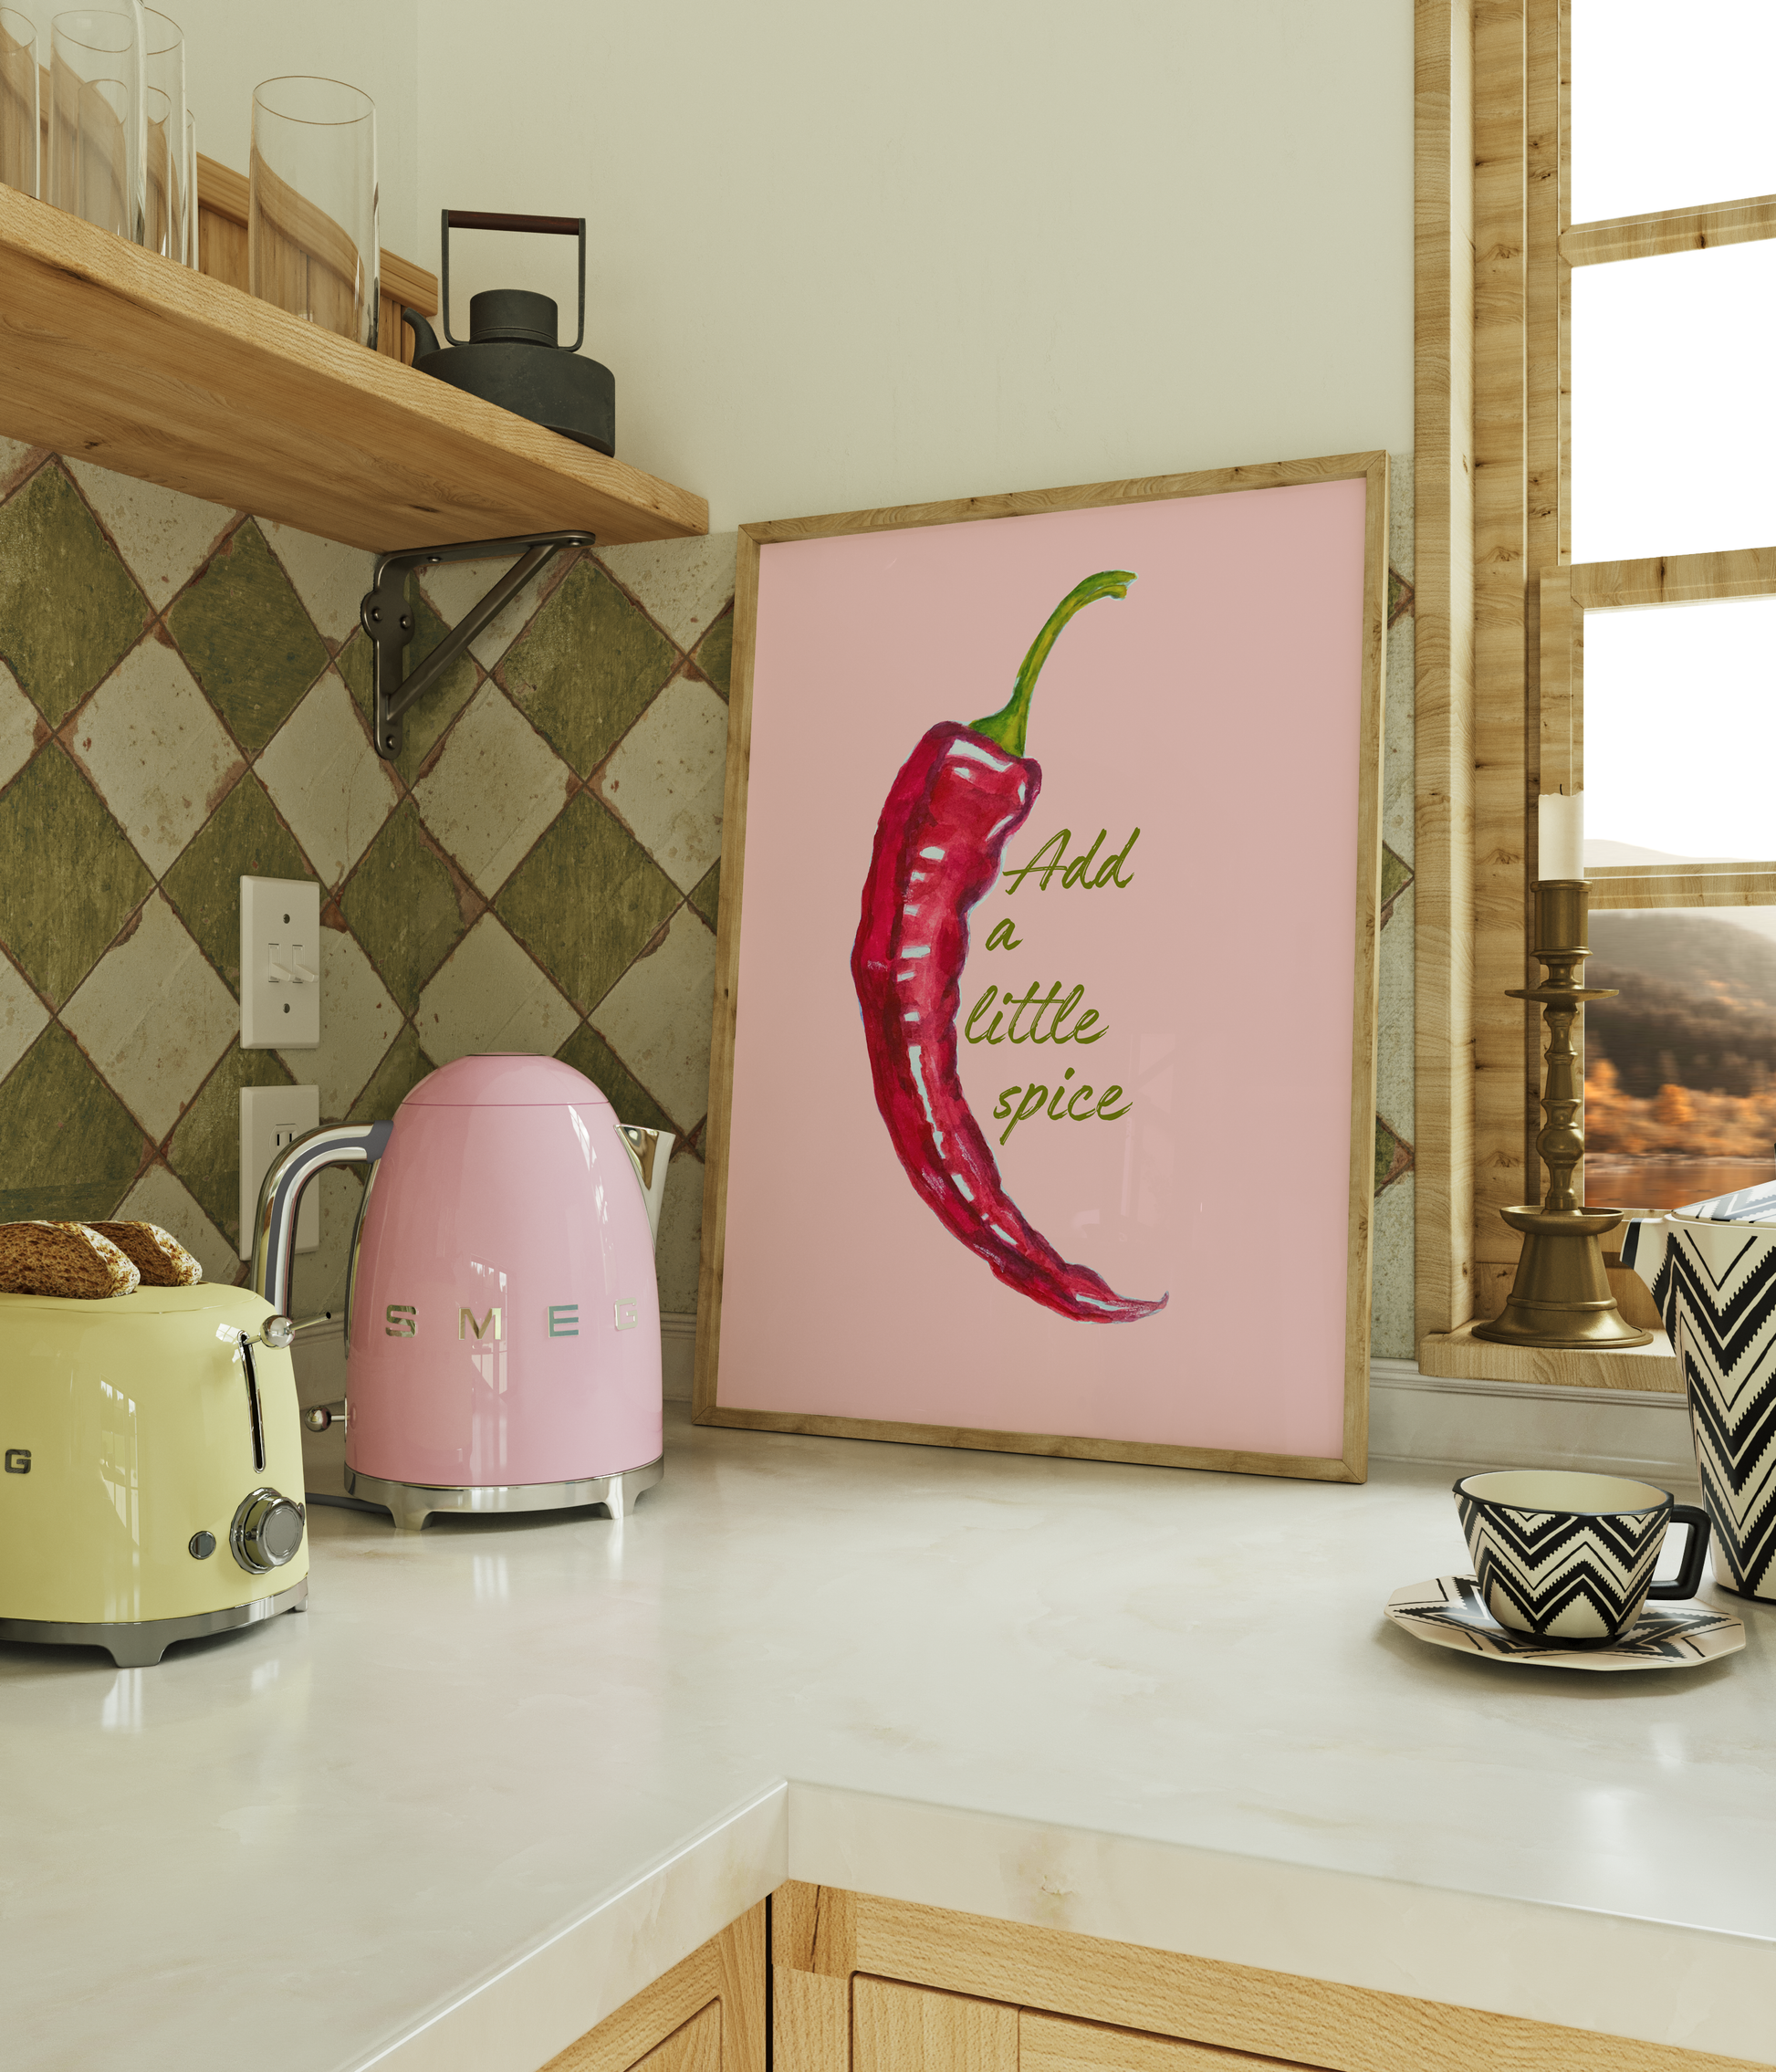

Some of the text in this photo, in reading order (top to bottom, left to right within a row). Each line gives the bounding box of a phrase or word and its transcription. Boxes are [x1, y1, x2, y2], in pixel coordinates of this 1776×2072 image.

[1002, 827, 1140, 895] Add
[986, 918, 1023, 950] a
[965, 981, 1109, 1044] little
[993, 1067, 1133, 1146] spice
[385, 1297, 638, 1341] SMEG
